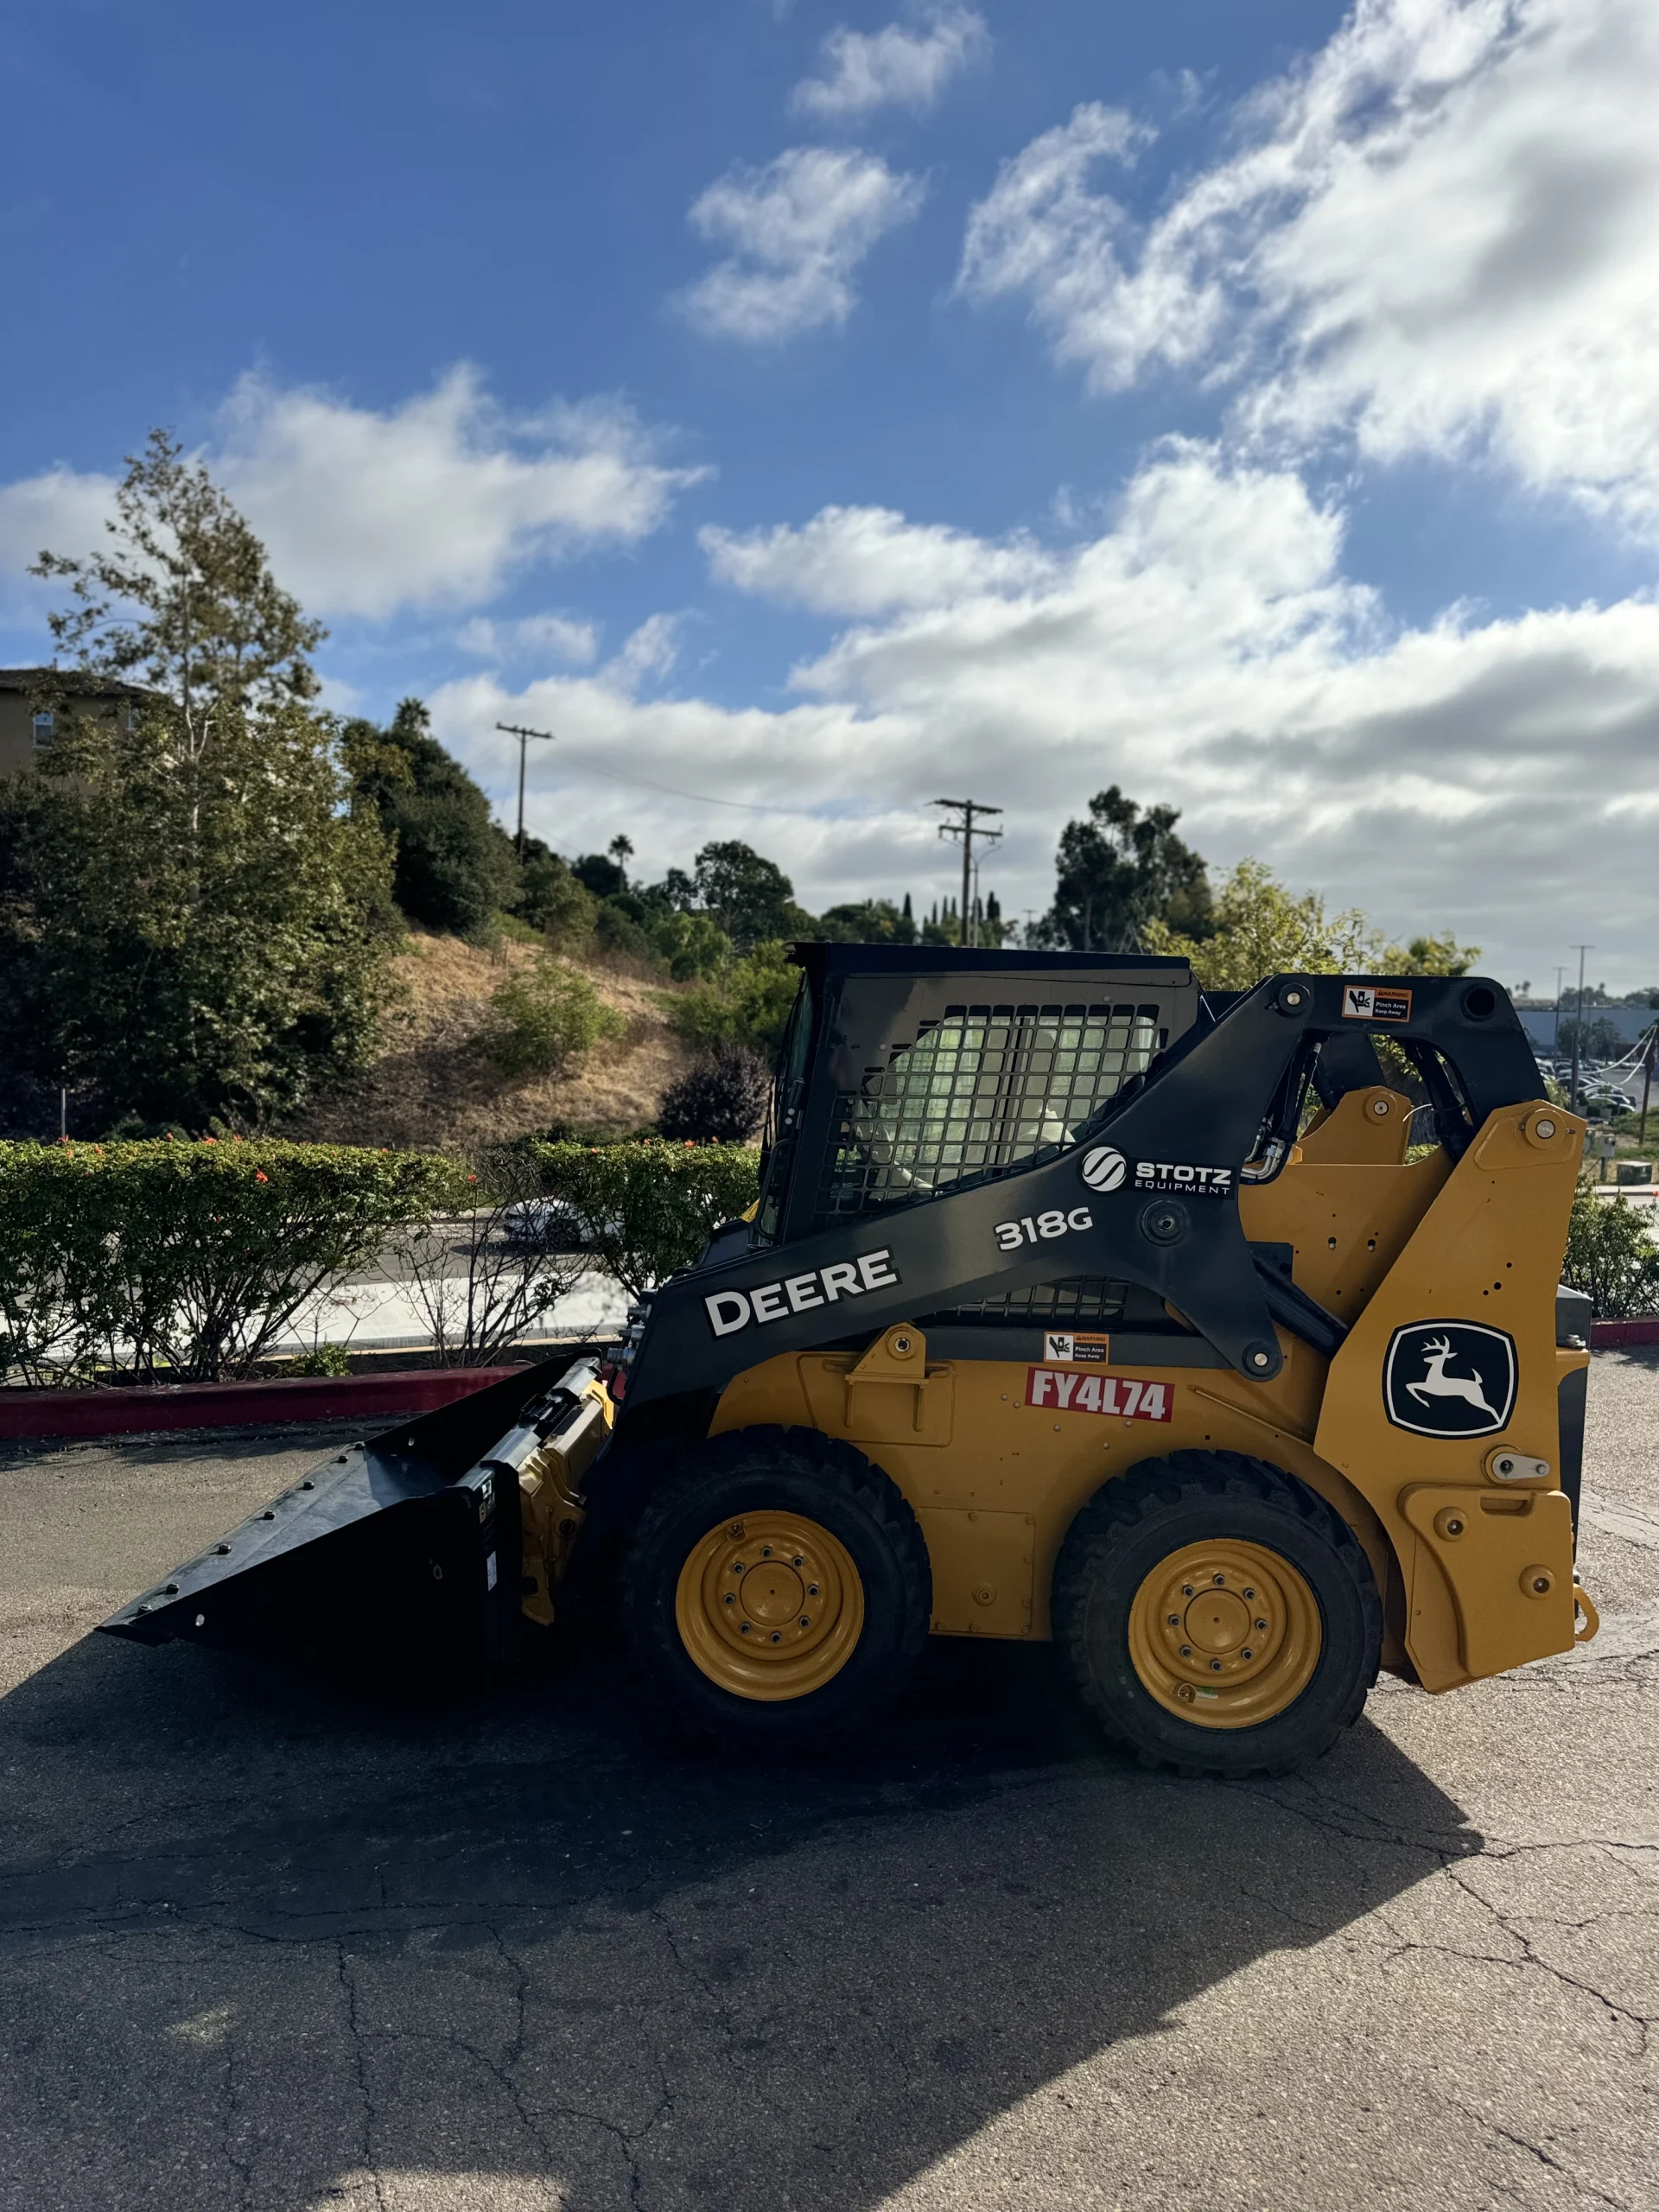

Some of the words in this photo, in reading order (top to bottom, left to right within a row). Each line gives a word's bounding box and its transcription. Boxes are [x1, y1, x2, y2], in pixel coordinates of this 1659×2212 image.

[1135, 1162, 1232, 1185] STOTZ
[1135, 1179, 1230, 1195] EQUIPMENT
[995, 1206, 1093, 1250] 318G
[704, 1249, 898, 1337] DEERE
[1031, 1370, 1166, 1420] FY4L74
